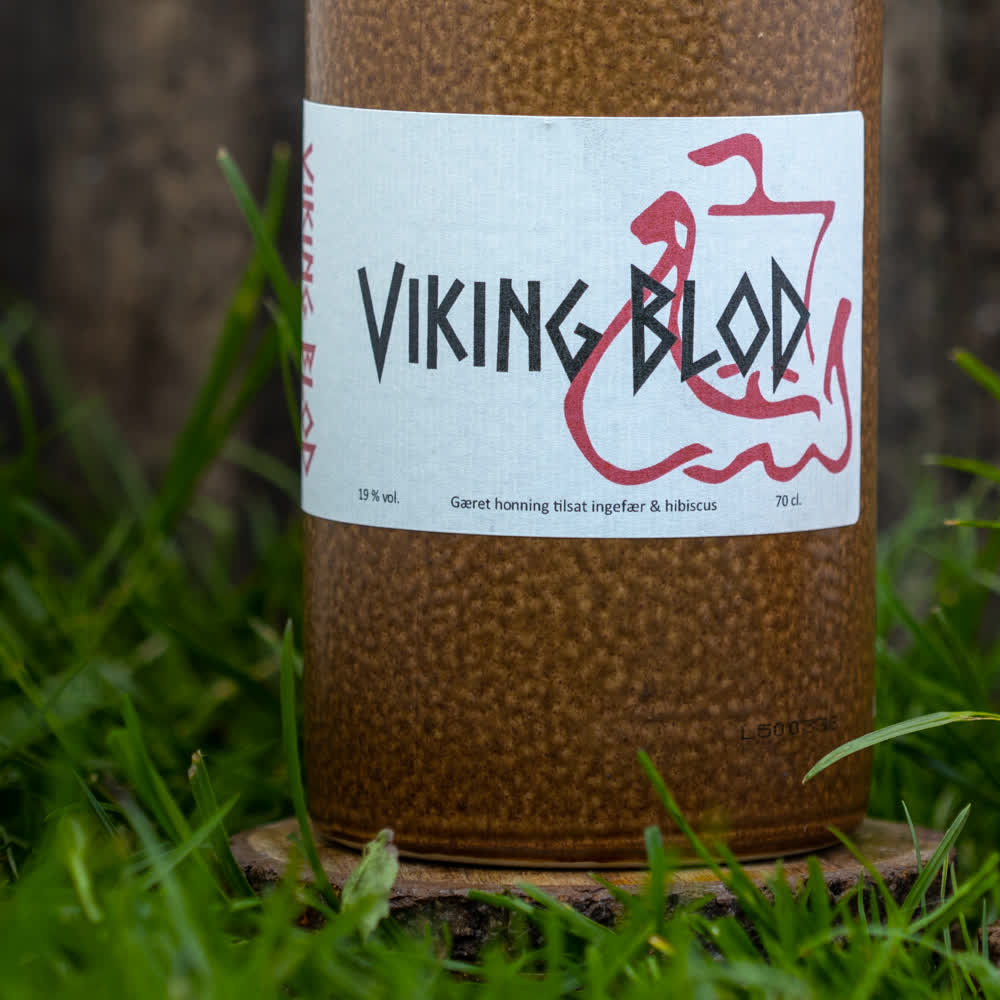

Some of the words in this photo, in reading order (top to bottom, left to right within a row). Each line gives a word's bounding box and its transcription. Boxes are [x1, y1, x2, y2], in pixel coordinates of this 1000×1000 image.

[357, 261, 602, 383] VIKING
[630, 256, 811, 396] BLOD
[358, 487, 370, 501] 19
[371, 489, 380, 502] %
[382, 490, 400, 504] vol.
[775, 494, 789, 507] 70
[450, 495, 491, 510] Gæret
[494, 496, 550, 514] honning
[553, 499, 588, 513] tilsat
[591, 499, 647, 516] ingefær
[650, 499, 661, 513] &
[665, 498, 718, 513] hibiscus
